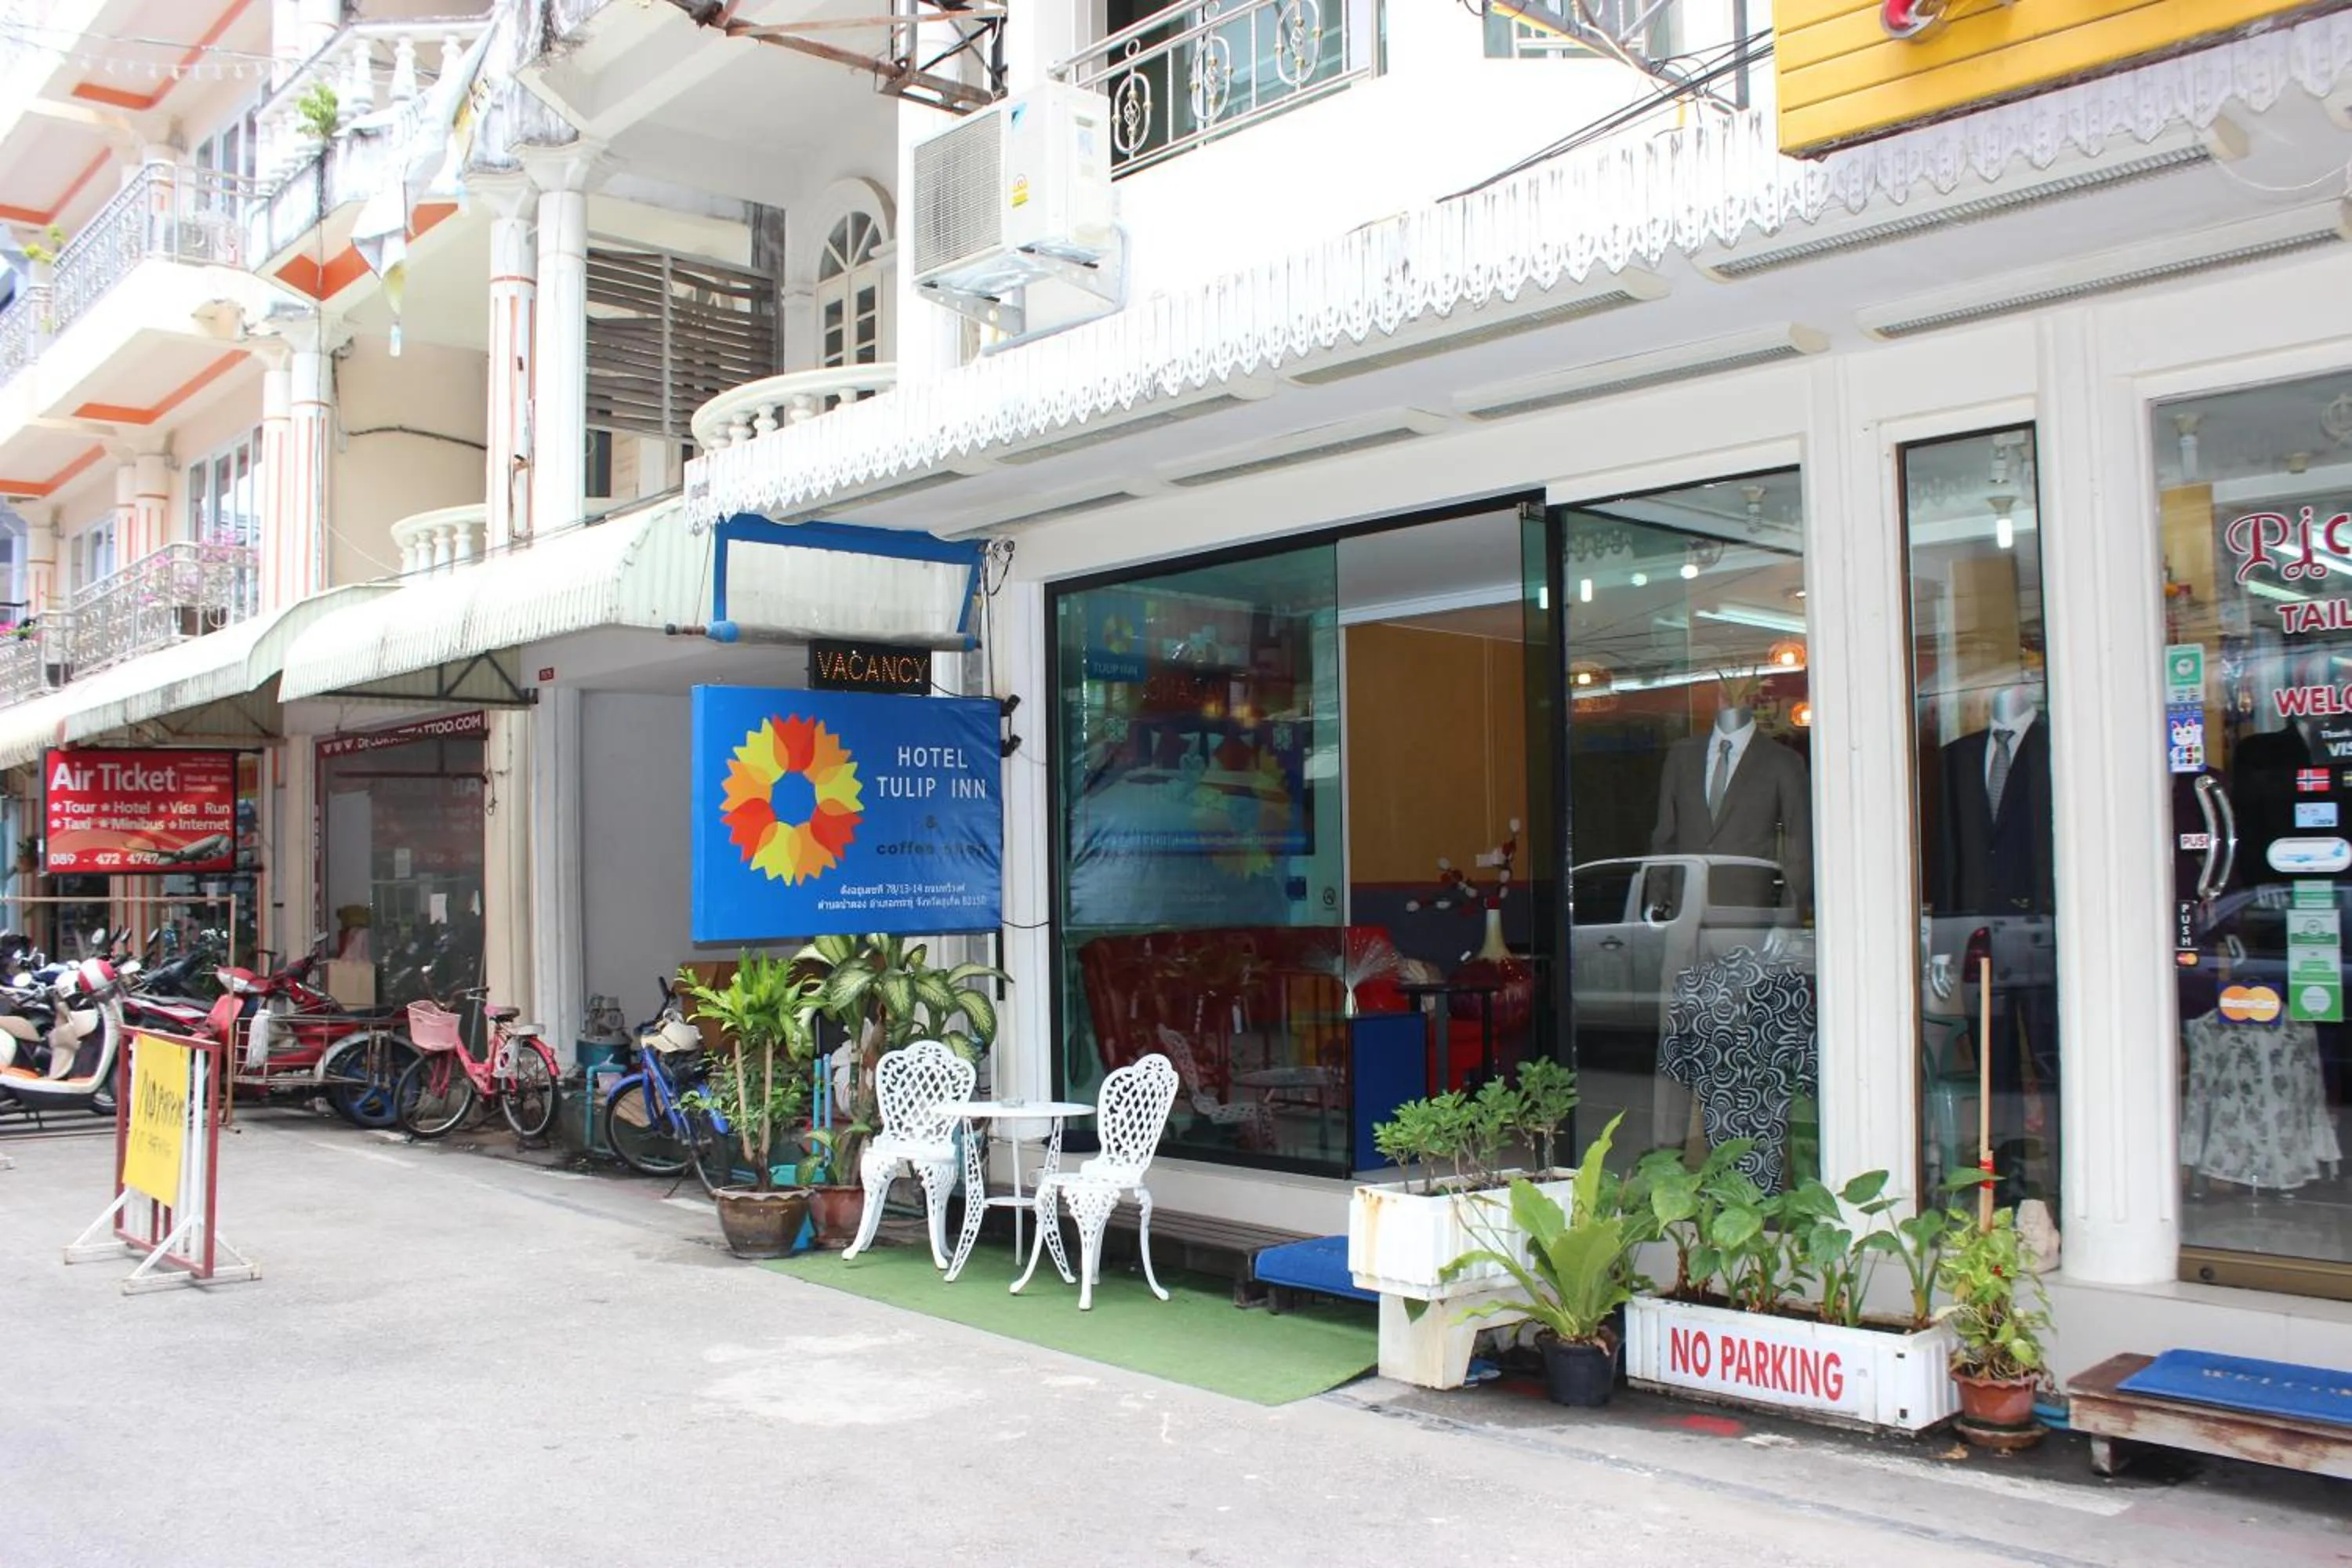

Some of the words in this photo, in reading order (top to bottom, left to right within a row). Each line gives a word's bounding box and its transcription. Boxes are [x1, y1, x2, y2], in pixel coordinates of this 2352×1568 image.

[2277, 599, 2352, 633] TAIL
[817, 651, 929, 684] VACANCY
[898, 746, 968, 768] HOTEL
[50, 762, 95, 792] Air
[97, 762, 177, 793] Ticket
[876, 776, 936, 798] TULIP
[952, 779, 987, 800] INN
[63, 800, 96, 814] Tour
[114, 800, 151, 815] Hotel
[169, 802, 197, 815] Visa
[205, 802, 230, 815] Run
[63, 818, 92, 830] Taxi
[111, 818, 165, 831] Minibus
[179, 818, 230, 831] Internet
[876, 839, 935, 855] coffee
[49, 853, 76, 866] 089
[95, 853, 121, 866] 472
[1671, 1327, 1711, 1378] NO
[1721, 1335, 1844, 1402] PARKING
